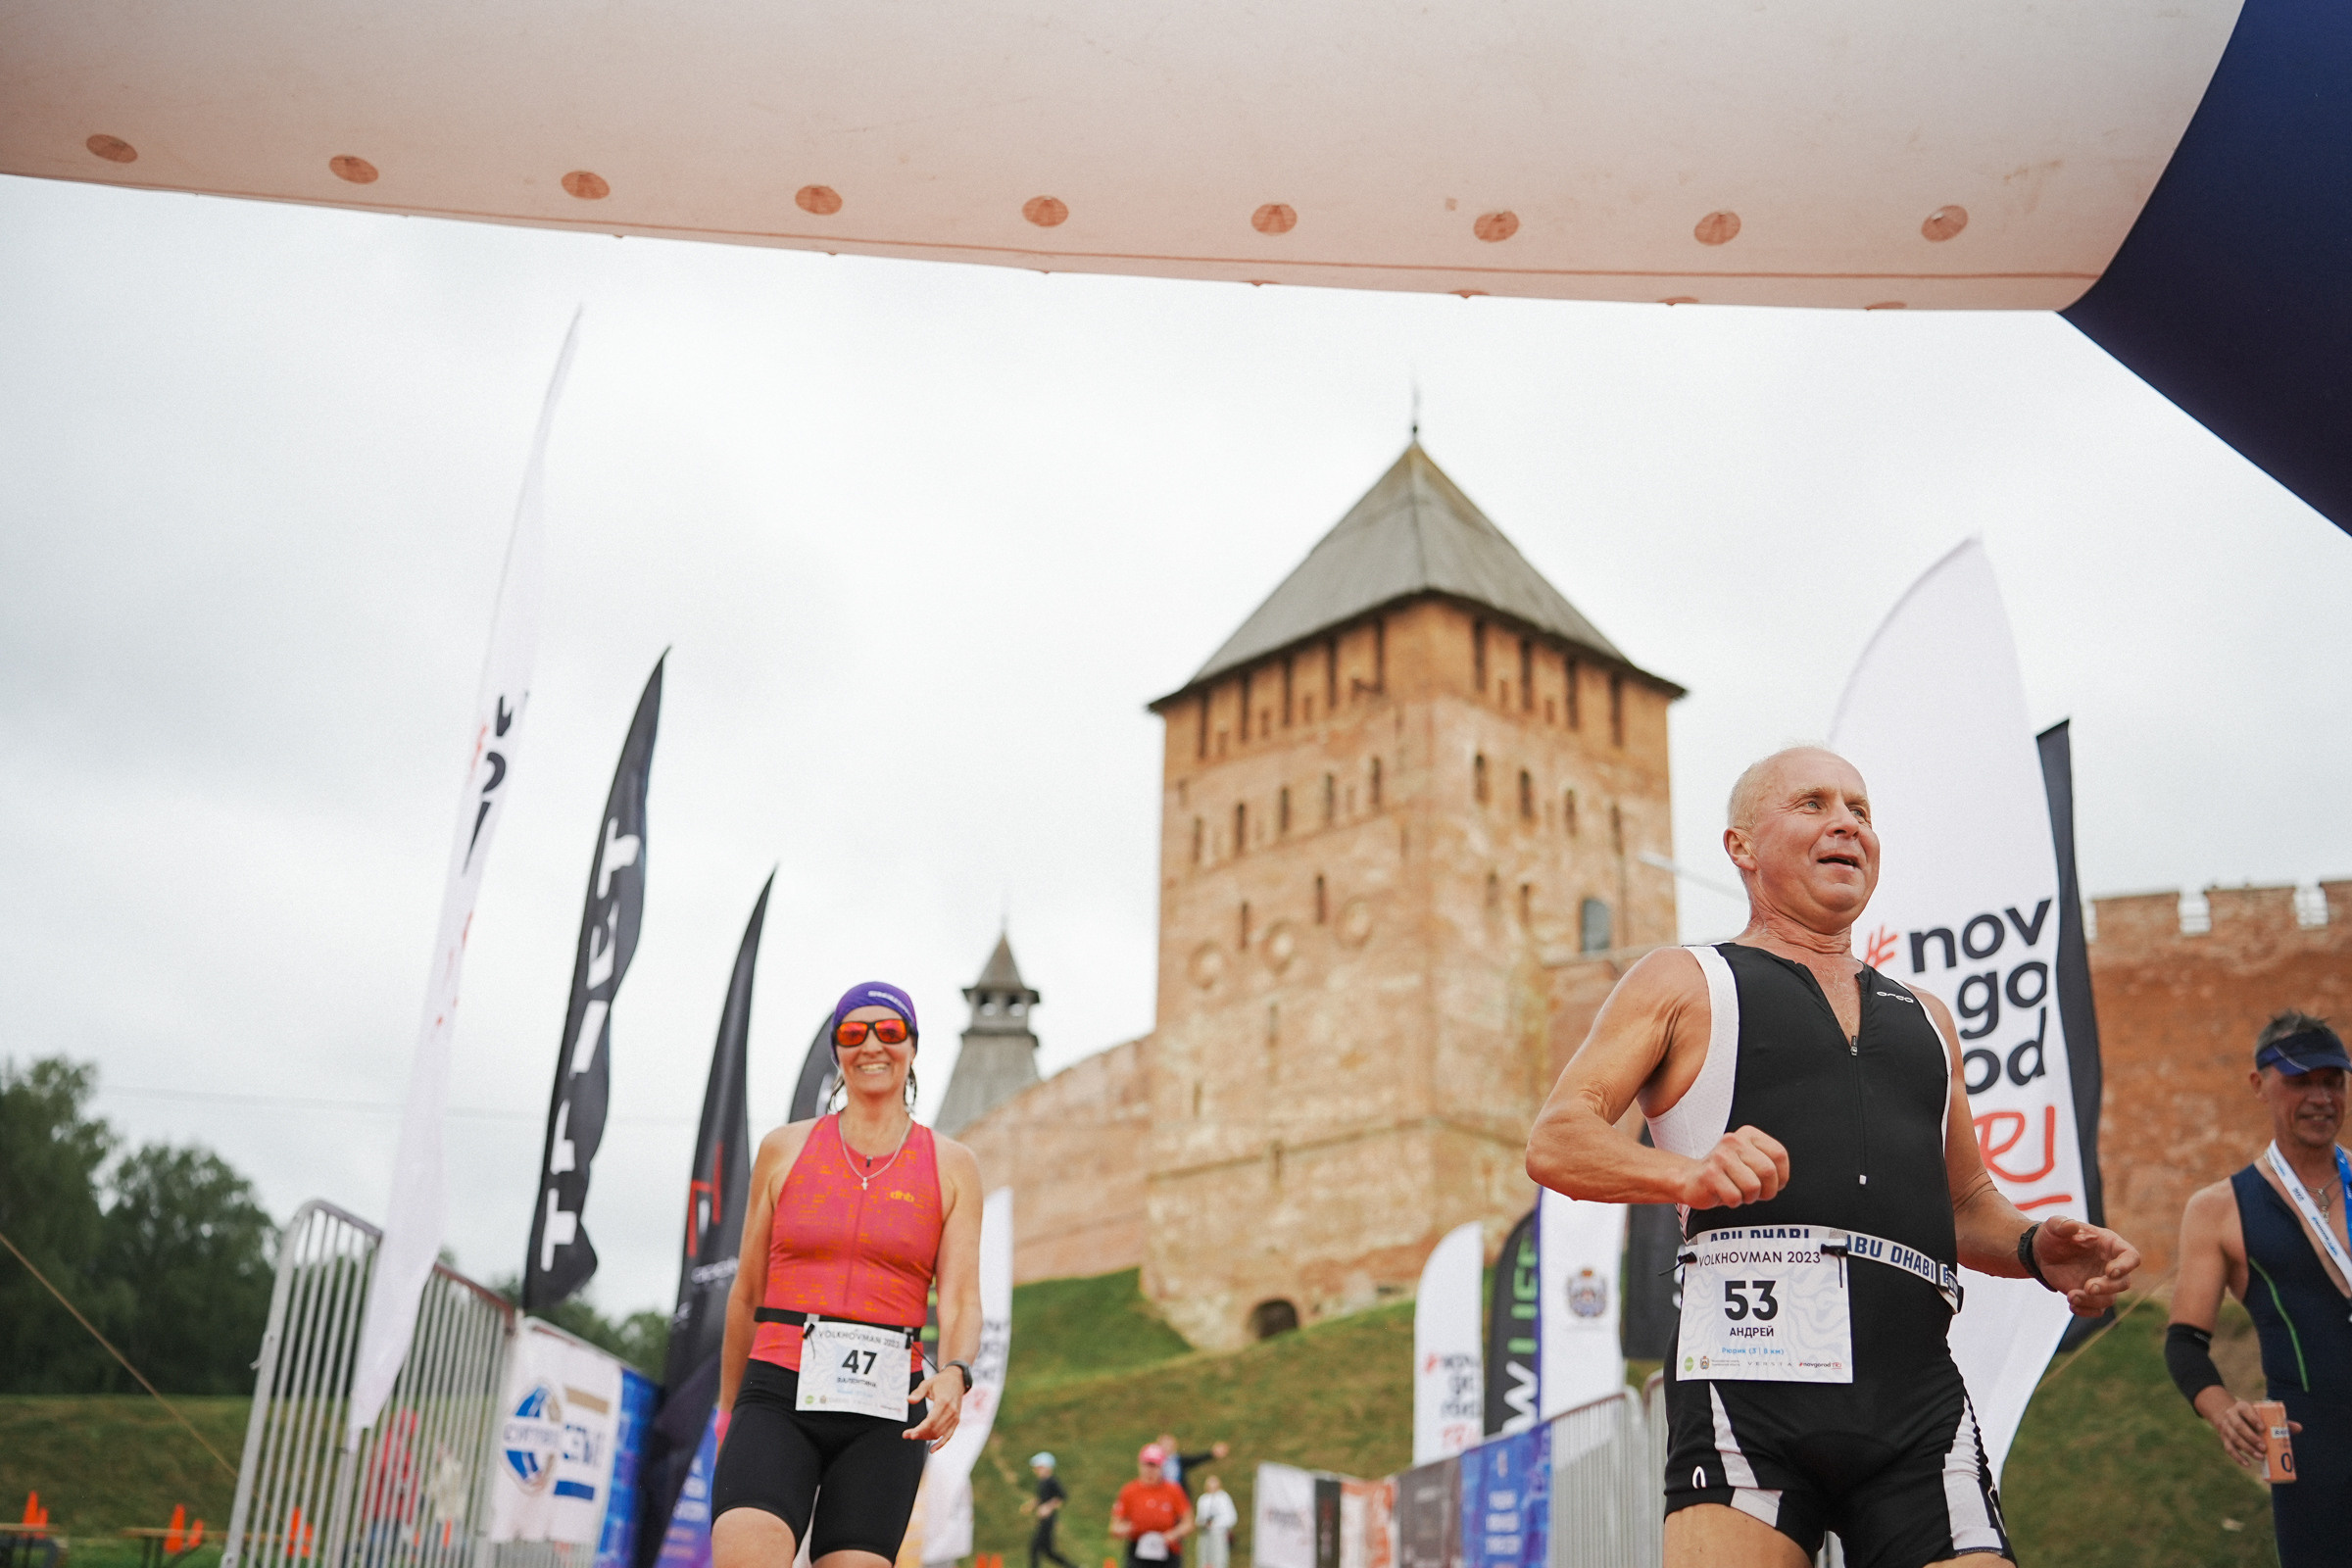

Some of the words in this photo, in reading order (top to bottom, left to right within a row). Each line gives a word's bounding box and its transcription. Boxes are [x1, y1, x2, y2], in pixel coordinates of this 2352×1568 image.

[1877, 991, 1914, 1004] orca
[1699, 1250, 1783, 1267] VOLKHOVMAN
[1788, 1250, 1821, 1263] 2023
[1890, 1246, 1935, 1280] DHABI
[1724, 1280, 1779, 1321] 53
[1730, 1325, 1775, 1339] АНДРЕЙ
[842, 1349, 877, 1375] 47
